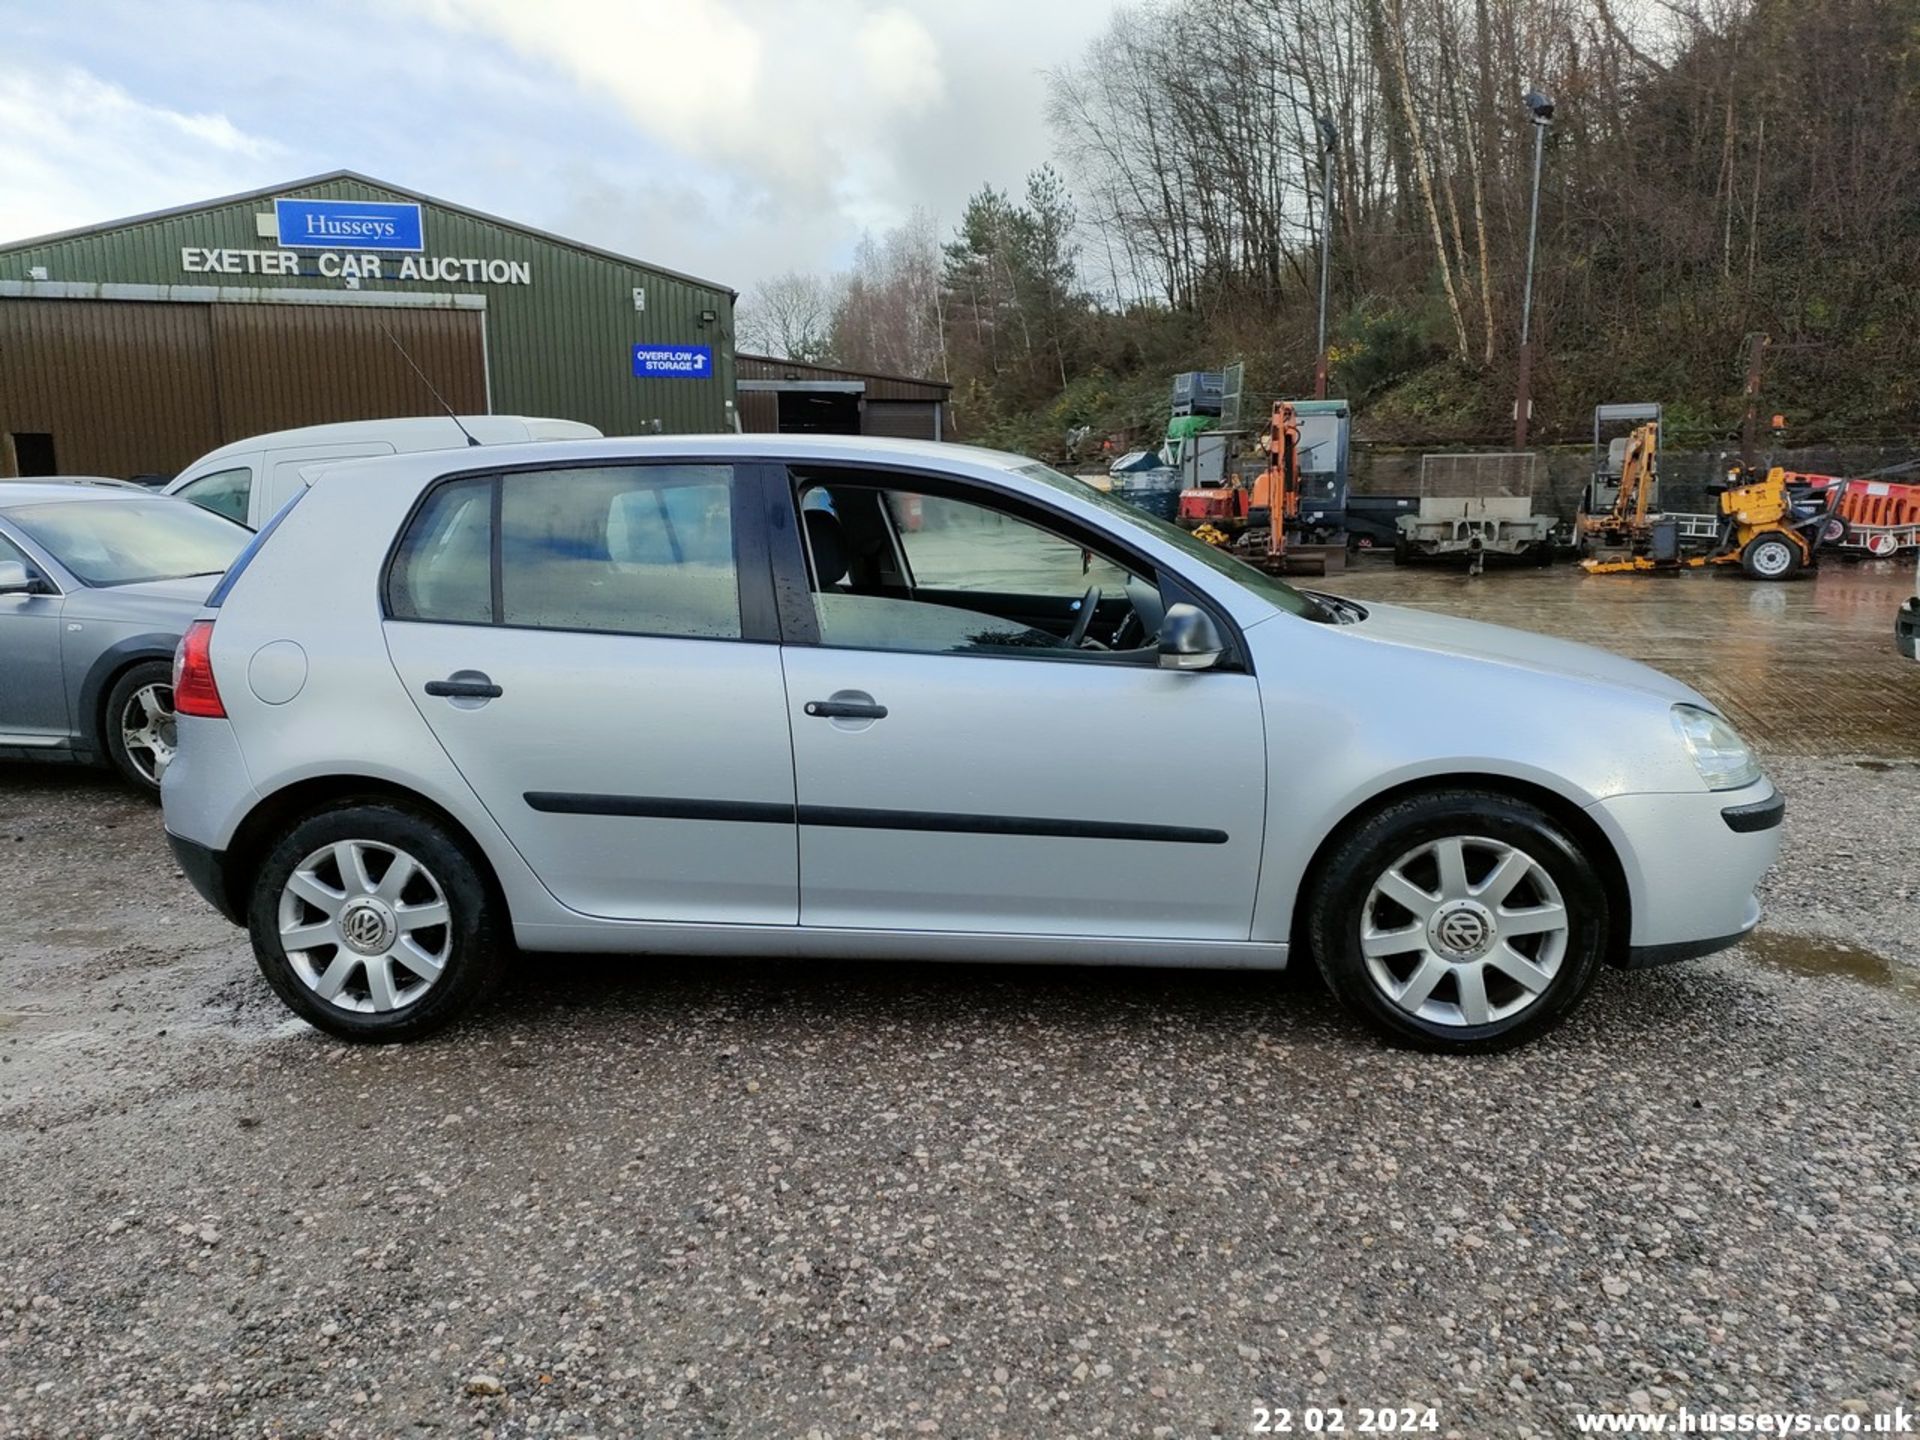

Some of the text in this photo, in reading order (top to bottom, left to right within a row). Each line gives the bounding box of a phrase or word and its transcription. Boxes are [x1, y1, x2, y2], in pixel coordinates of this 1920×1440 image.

[305, 214, 396, 240] Husseys
[181, 247, 531, 285] EXETER CAR AUCTION
[637, 351, 693, 361] OVERFLOW
[645, 361, 693, 371] STORAGE
